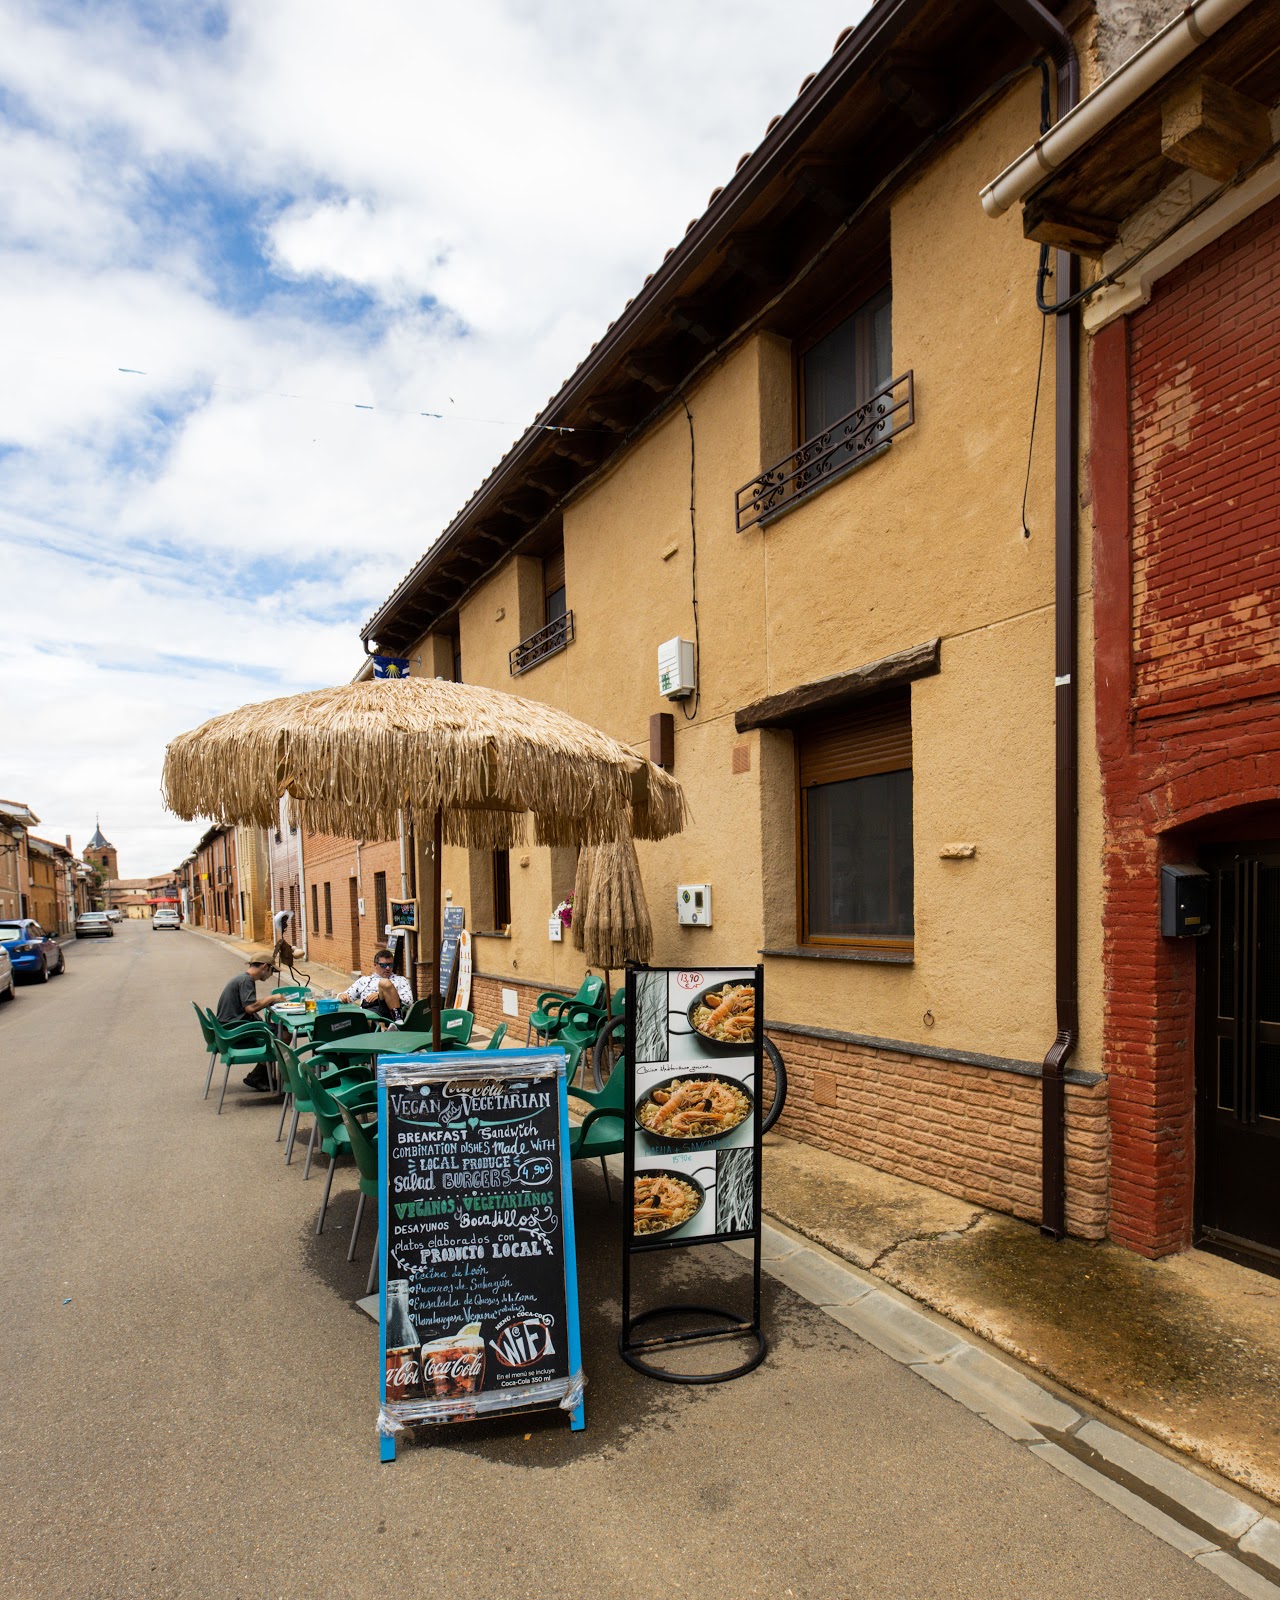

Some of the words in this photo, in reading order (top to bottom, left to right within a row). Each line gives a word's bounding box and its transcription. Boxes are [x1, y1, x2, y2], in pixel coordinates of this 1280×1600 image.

[391, 1094, 441, 1116] VEGAN
[441, 1101, 463, 1124] and
[461, 1092, 551, 1117] VEGETARIAN
[397, 1130, 468, 1144] BREAKFAST
[477, 1120, 539, 1140] Sandwich
[460, 1141, 490, 1155] DISHES
[420, 1158, 460, 1171] LOCAL
[462, 1154, 512, 1171] PRODUCE
[394, 1172, 436, 1194] Salad
[443, 1169, 511, 1190] BURGERS
[394, 1199, 455, 1221] VEGANOS
[462, 1191, 555, 1211] VEGETARIANOS
[394, 1221, 450, 1235] DESAYUNOS
[460, 1209, 539, 1229] Bocadillos
[428, 1233, 490, 1248] elaborados
[498, 1233, 515, 1242] con
[420, 1246, 485, 1265] PRODUCTO
[492, 1241, 542, 1259] LOCAL
[464, 1263, 489, 1277] León
[470, 1274, 513, 1295] Sahagún
[414, 1293, 461, 1310] Ensalada
[464, 1292, 473, 1305] de
[424, 1352, 484, 1382] Coca-Cola
[496, 1373, 504, 1381] En
[511, 1370, 528, 1379] menú
[501, 1377, 531, 1388] Coca-Cola
[531, 1375, 543, 1384] 350
[543, 1374, 551, 1382] ml
